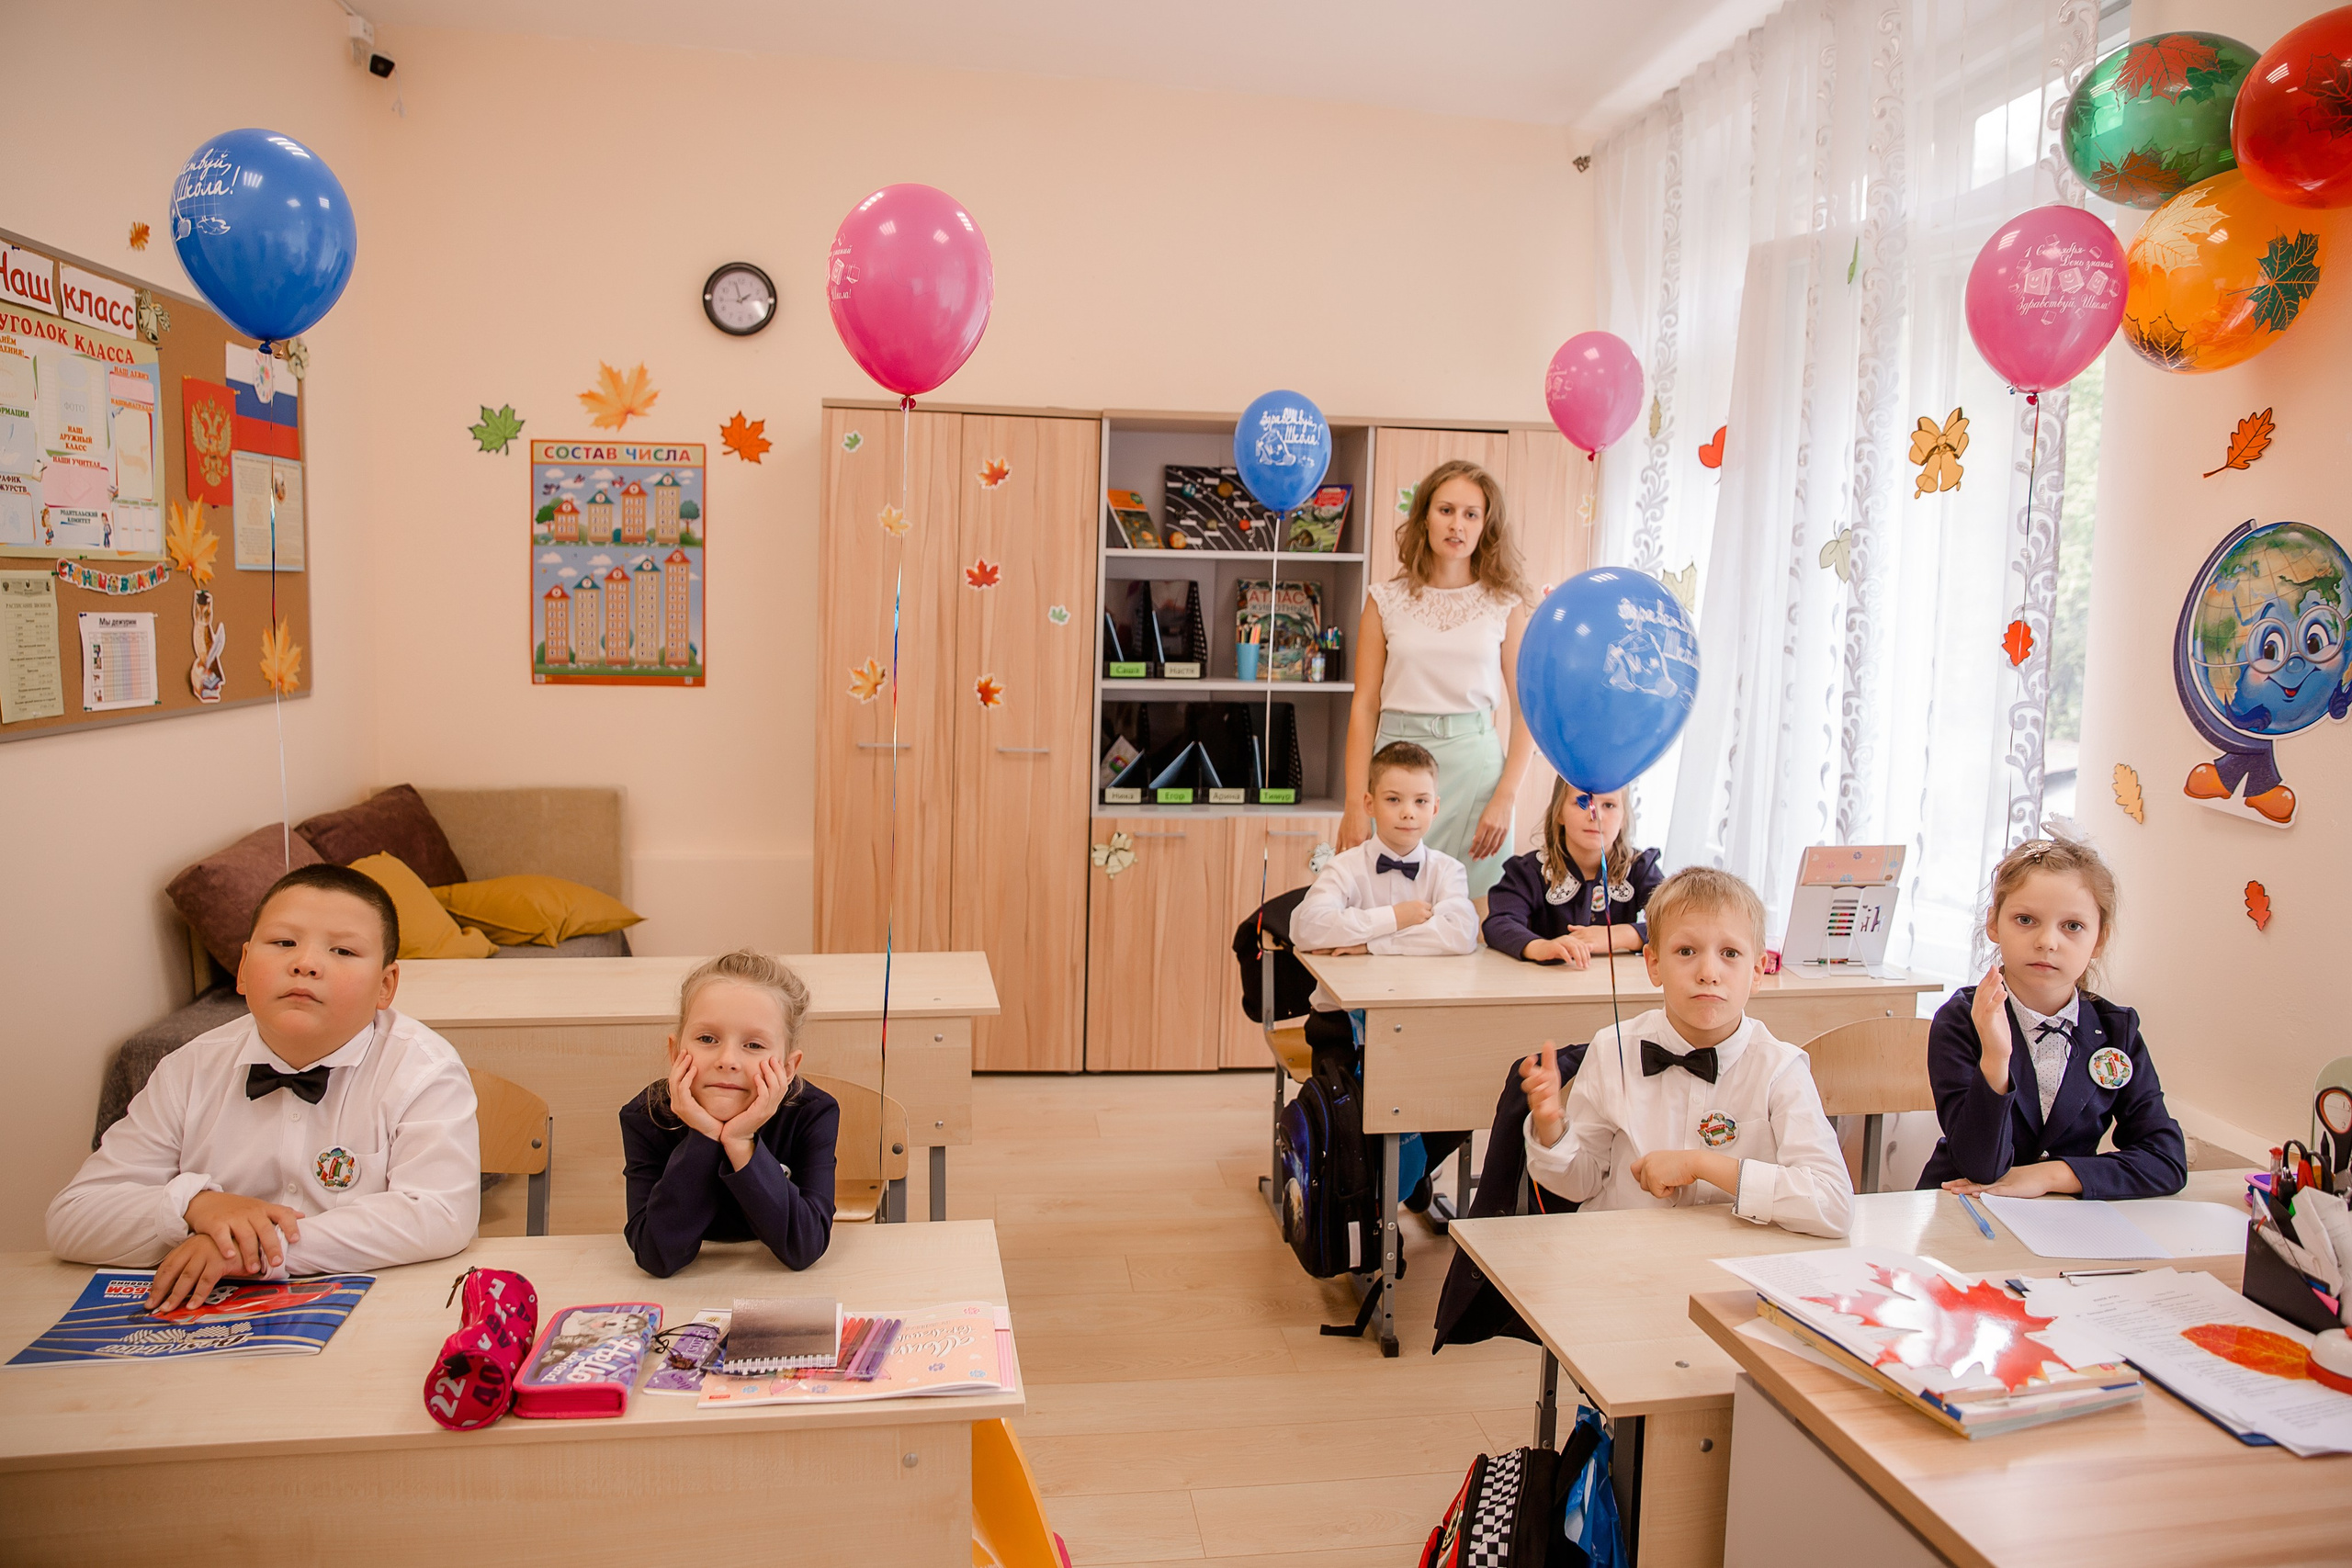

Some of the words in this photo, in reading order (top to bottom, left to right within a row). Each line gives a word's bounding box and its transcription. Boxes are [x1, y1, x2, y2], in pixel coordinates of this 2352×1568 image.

[175, 166, 241, 202] Школа!
[2024, 245, 2032, 258] 1
[2060, 254, 2084, 266] День
[2085, 260, 2114, 271] знаний
[0, 251, 51, 304] Наш
[63, 283, 134, 330] класс
[2017, 296, 2076, 315] Здравствуй,
[2081, 294, 2111, 310] Школа!
[0, 313, 68, 346] УГОЛОК
[74, 334, 135, 365] КЛАССА
[114, 366, 129, 377] НАШ
[130, 370, 150, 380] ДЕВИЗ
[64, 401, 85, 412] ФОТО
[67, 425, 83, 434] НАШ
[1284, 423, 1322, 446] Школа!
[60, 433, 93, 445] ДРУЖНЫЙ
[65, 443, 87, 451] КЛАСС
[544, 446, 617, 460] СОСТАВ
[626, 447, 691, 462] ЧИСЛА
[52, 456, 71, 465] НАШИ
[71, 458, 101, 468] УЧИТЕЛЯ
[0, 483, 27, 492] ЖУРСТВ
[60, 509, 98, 517] РОДИТЕЛЬСКИЙ
[99, 617, 111, 626] Мы
[1115, 665, 1139, 674] Саша
[1169, 666, 1194, 674] Настя
[1165, 793, 1185, 801] Егор
[1264, 793, 1292, 801] Тимур
[169, 1332, 254, 1354] Best
[566, 1337, 641, 1382] Hello
[540, 1351, 586, 1382] friend
[430, 1377, 467, 1418] 22
